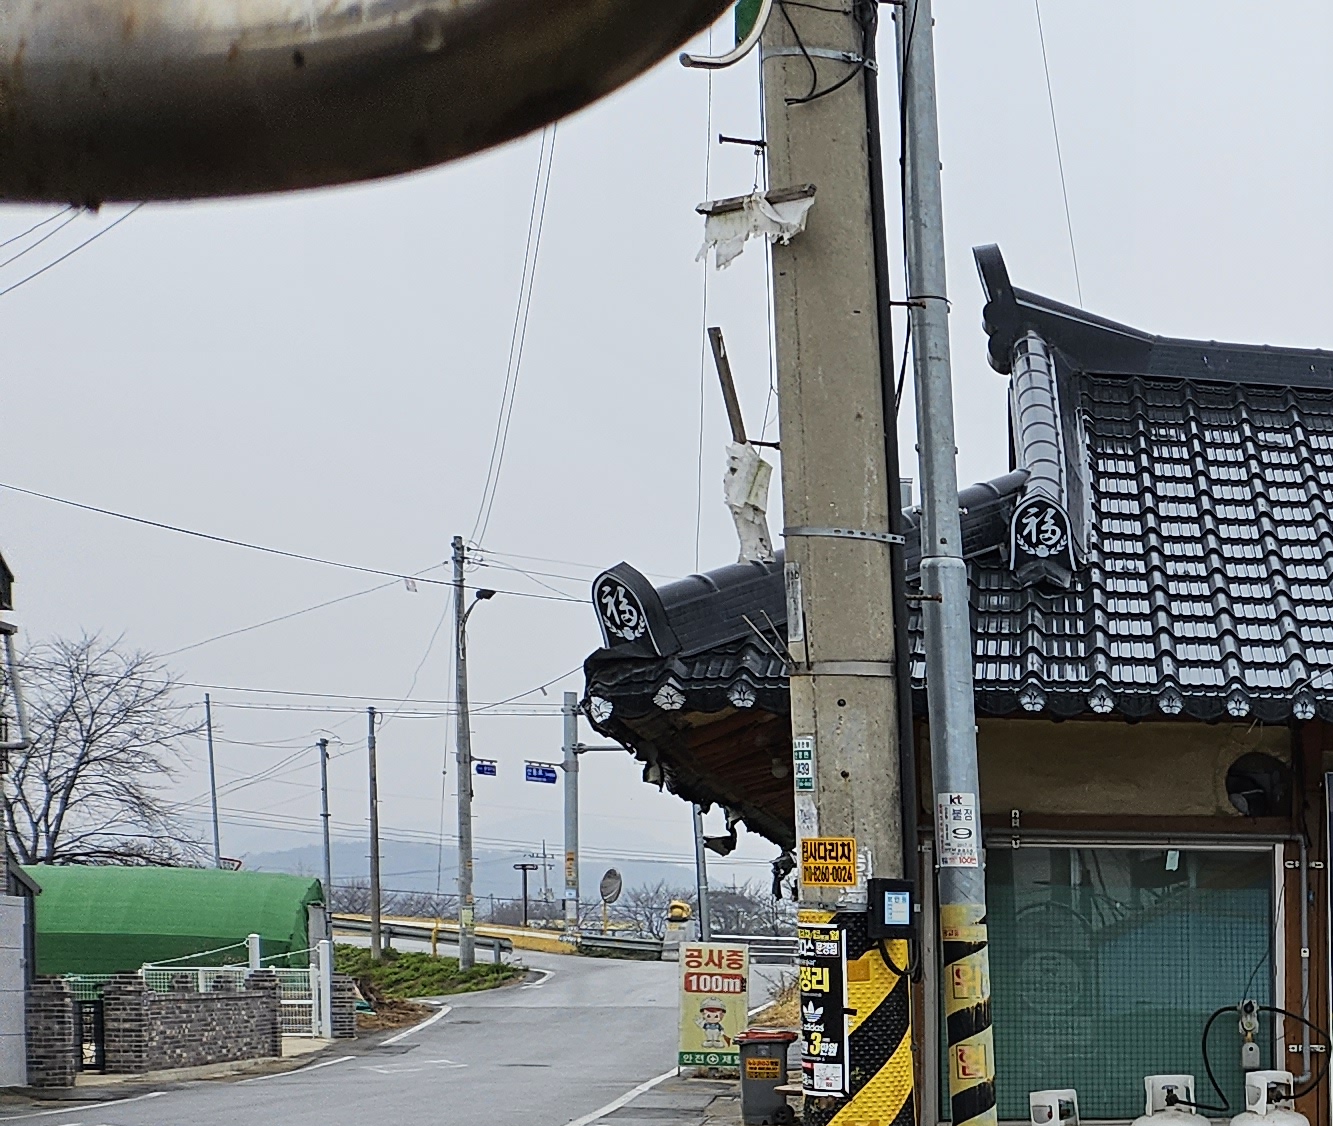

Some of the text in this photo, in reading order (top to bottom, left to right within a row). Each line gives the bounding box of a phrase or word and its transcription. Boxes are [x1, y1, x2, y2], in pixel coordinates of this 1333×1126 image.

[949, 794, 963, 805] kt
[952, 827, 973, 840] 9
[808, 841, 852, 863] 사다리차
[685, 948, 744, 970] 공사중
[682, 1054, 705, 1065] 안전
